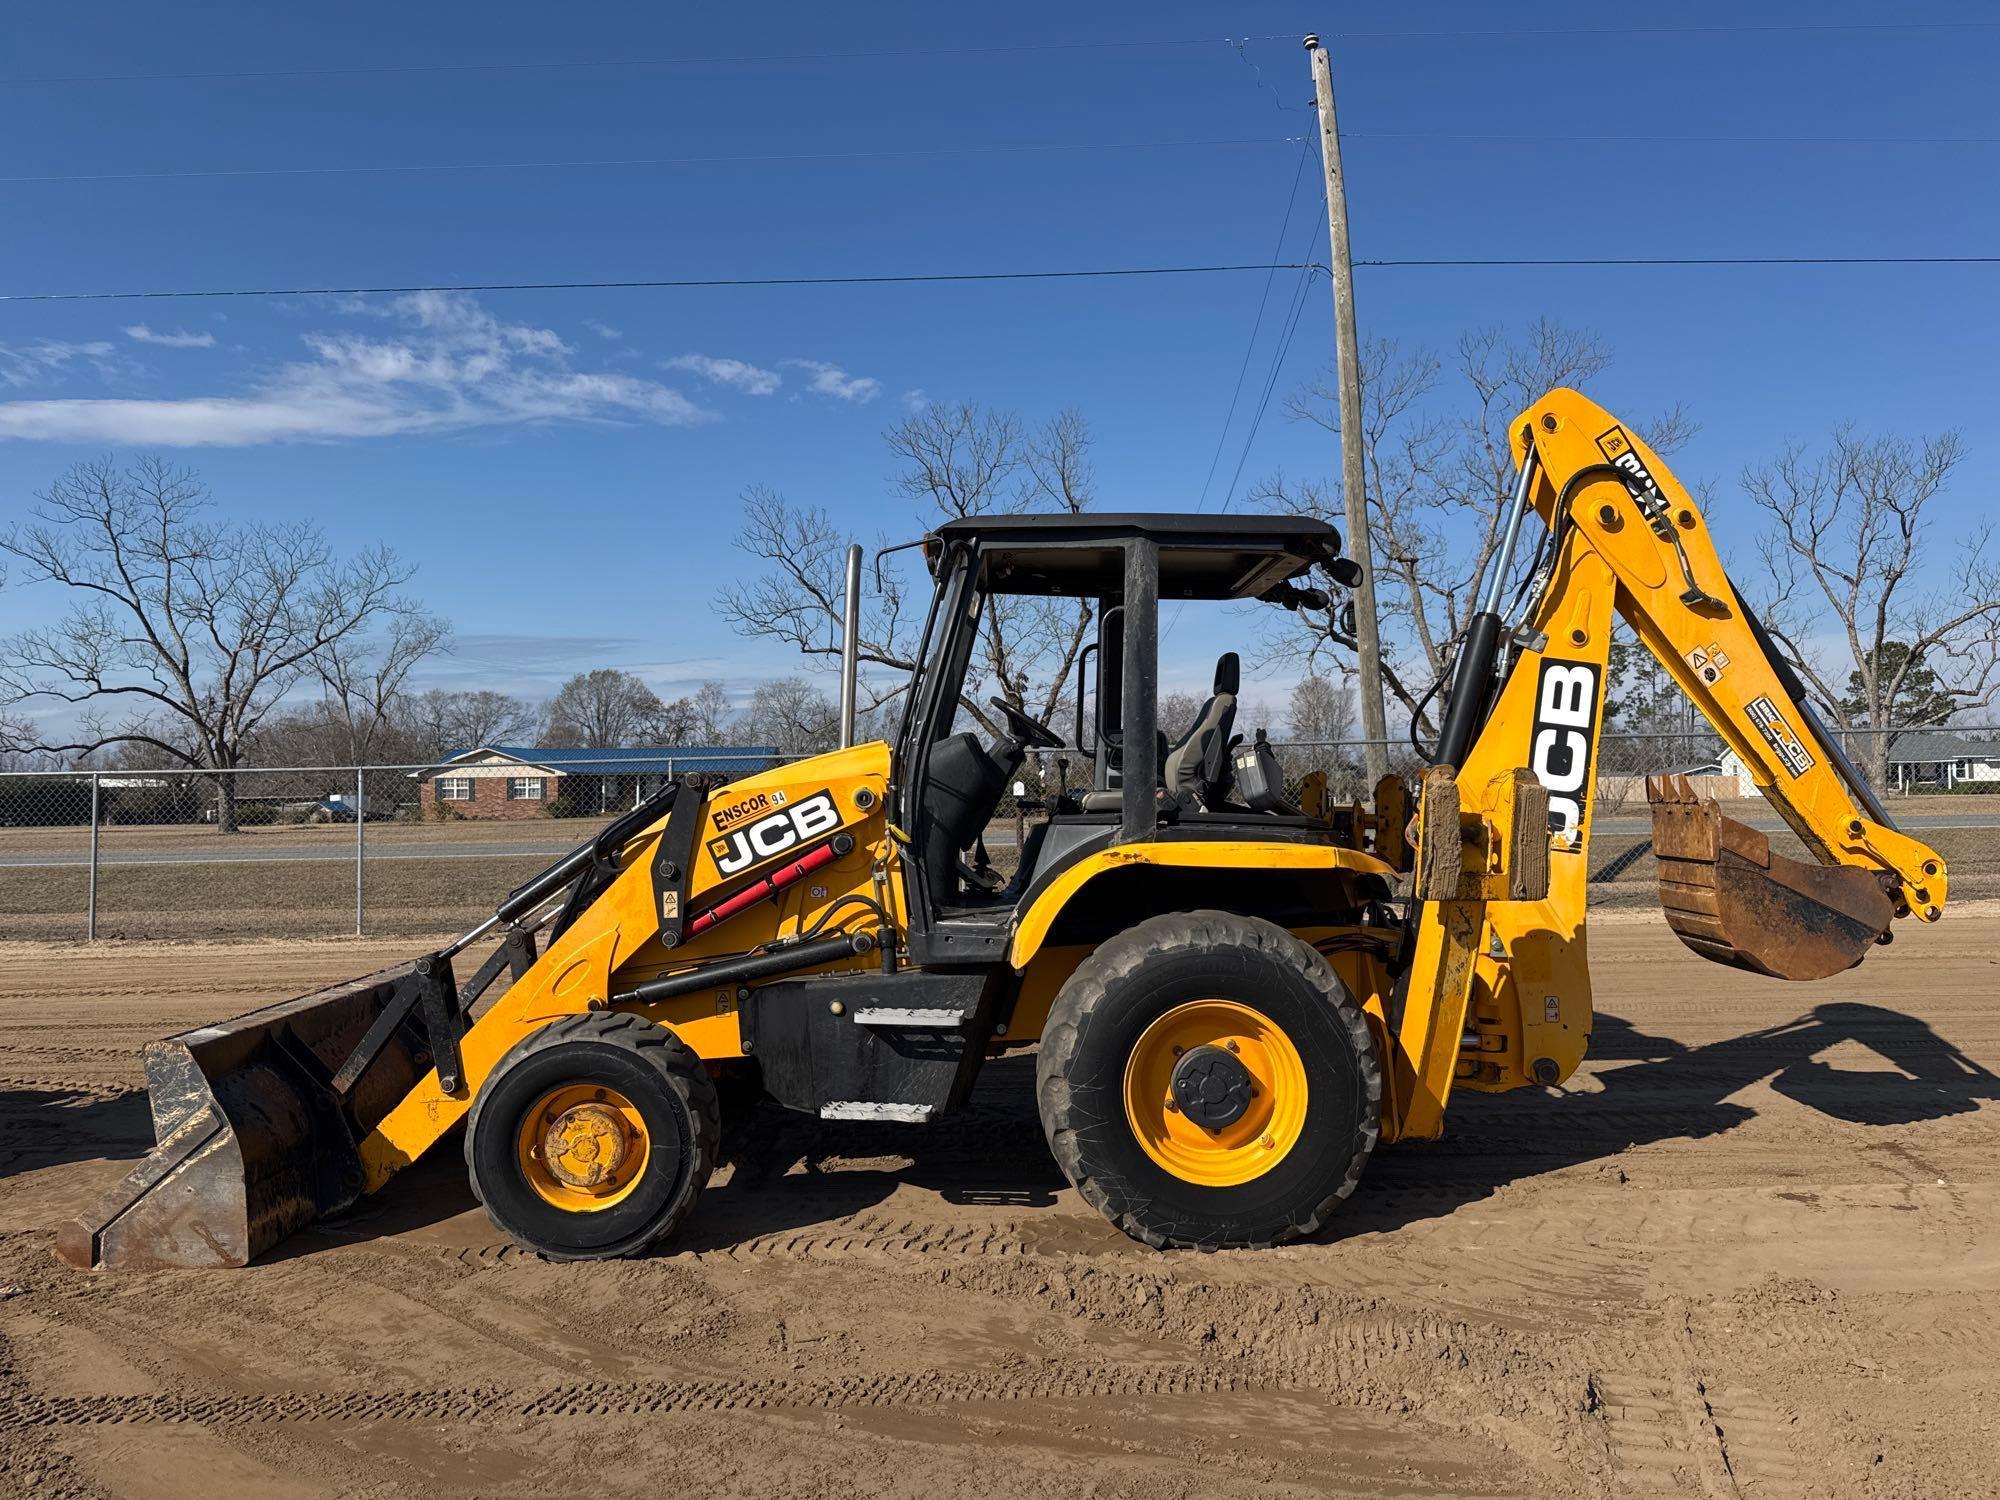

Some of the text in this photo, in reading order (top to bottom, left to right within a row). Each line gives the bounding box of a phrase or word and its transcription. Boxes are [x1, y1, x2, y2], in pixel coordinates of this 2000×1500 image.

[1533, 665, 1595, 847] JCB
[711, 793, 785, 832] ENSCOR 94
[718, 795, 838, 874] JCB
